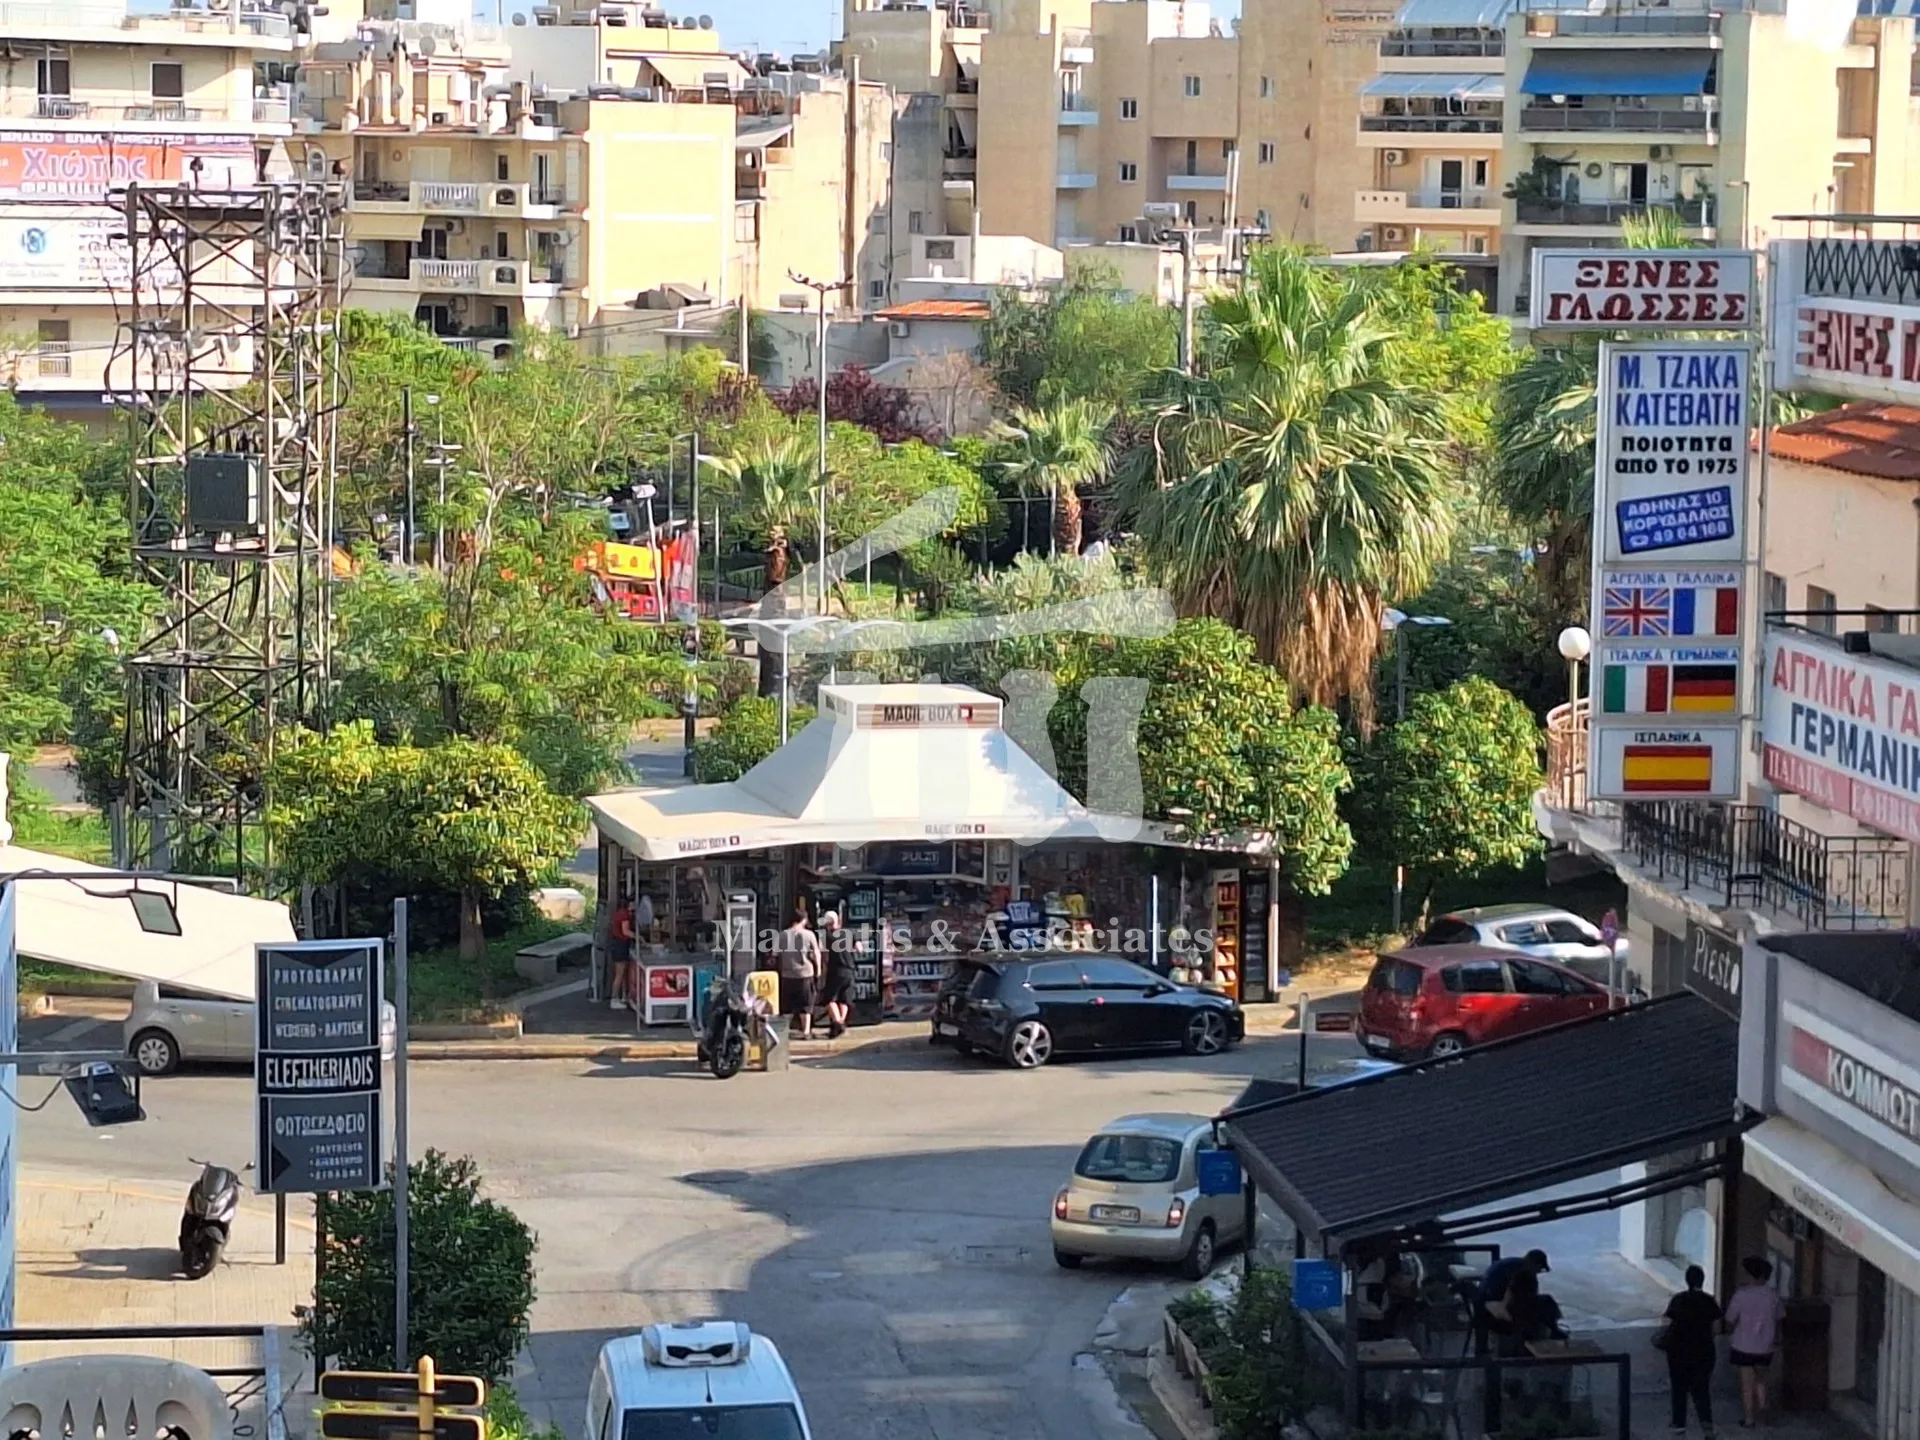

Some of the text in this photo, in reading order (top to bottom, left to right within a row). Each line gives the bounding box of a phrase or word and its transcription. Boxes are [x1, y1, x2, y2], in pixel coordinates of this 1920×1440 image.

[1575, 259, 1720, 288] ΞΕΝΕΣ
[1546, 292, 1746, 322] ΓΛΩΣΣΕΣ
[1796, 307, 1894, 378] ΞΕΝΕΣ
[1657, 355, 1739, 389] ΤΖΑΚΑ
[1616, 392, 1740, 426] ΚΑΤΕΒΑΤΗ
[1698, 458, 1738, 474] 1975
[1628, 491, 1723, 517] ΑΘΗΝΑΣ 10
[1623, 505, 1730, 532] ΚΟΡΥΔΑΛΛΟΣ
[1609, 572, 1736, 585] ΑΓΓΛΙΚΑ ΓΑΛΛΙΚΑ
[1610, 648, 1739, 661] ΙΤΑΛΙΚΑ ΓΕΡΜΑΝΙΚΑ
[1772, 646, 1876, 723] ΑΓΓΛΙΚΑ
[928, 705, 956, 721] BOX
[1634, 732, 1702, 743] ΙΣΠΑΝΙΚΑ
[1692, 926, 1740, 995] Piesto
[274, 967, 363, 984] PHOTOGRAPHY
[265, 1056, 374, 1089] ELEFTHERIADIS
